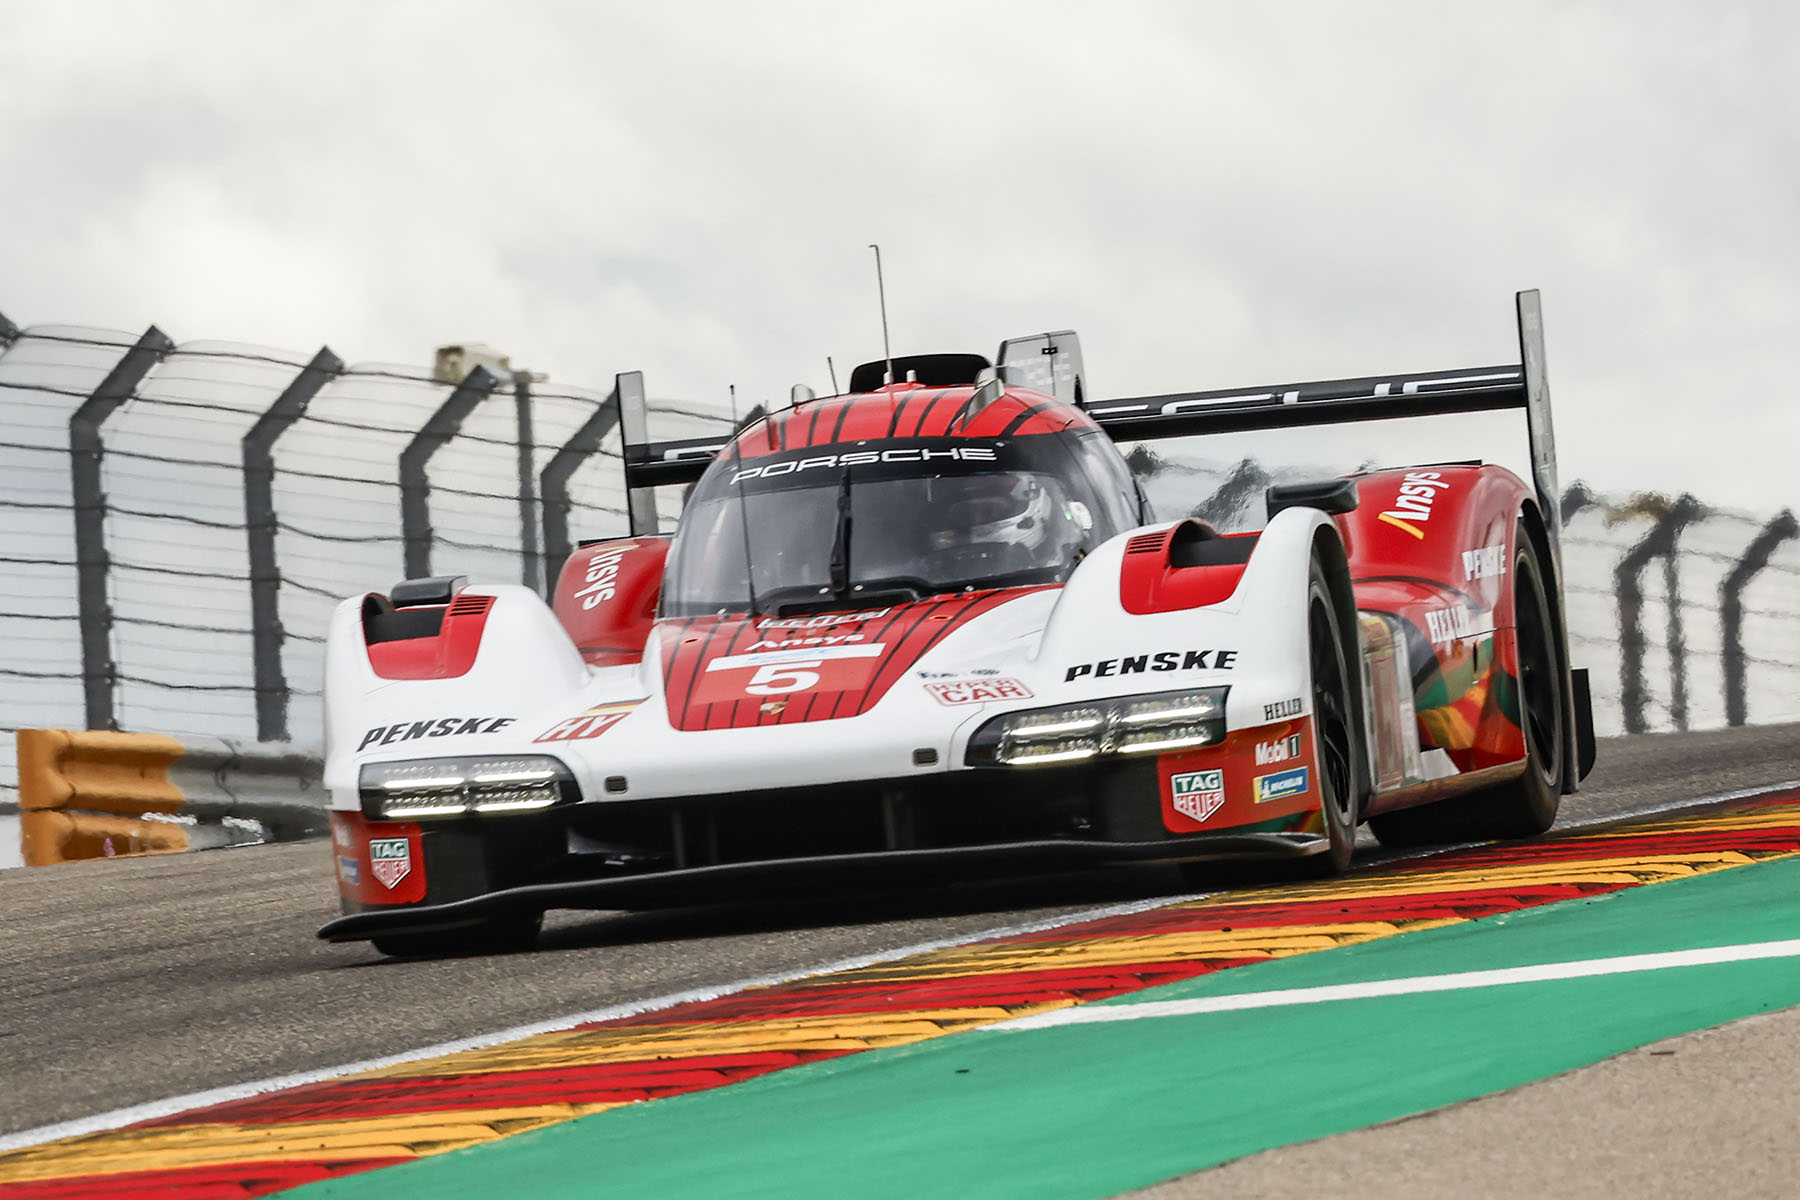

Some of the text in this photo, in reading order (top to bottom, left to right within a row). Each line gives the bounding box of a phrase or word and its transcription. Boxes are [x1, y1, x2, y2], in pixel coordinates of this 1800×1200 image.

[730, 447, 998, 485] PORSCHE
[1377, 472, 1450, 540] Ansys
[574, 545, 640, 610] Ansys
[744, 633, 865, 652] Ansys
[745, 660, 821, 695] 5
[1064, 649, 1239, 682] PENSKE
[941, 685, 1025, 702] CAR
[357, 717, 519, 753] PENSKE
[1290, 733, 1299, 759] 1
[1175, 771, 1220, 793] TAG
[371, 841, 406, 858] TAG
